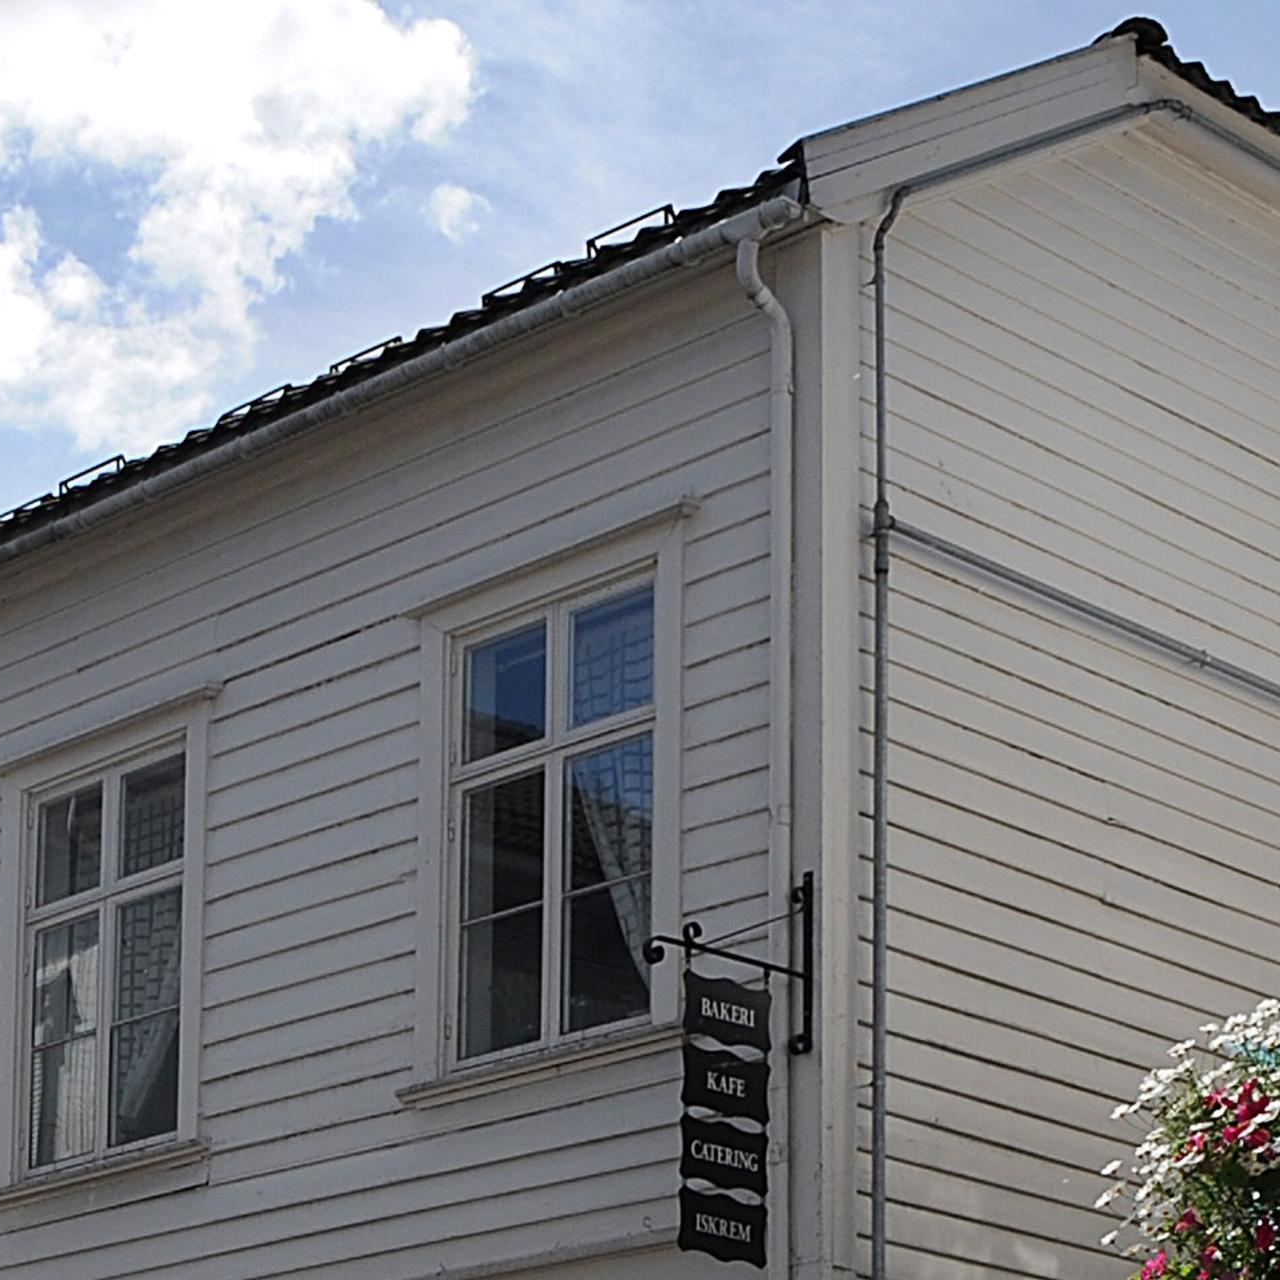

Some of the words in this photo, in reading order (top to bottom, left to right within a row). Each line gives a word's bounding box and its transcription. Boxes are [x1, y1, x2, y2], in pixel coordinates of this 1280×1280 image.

[701, 997, 755, 1027] BAKERI
[706, 1071, 746, 1097] KAFE
[690, 1140, 758, 1172] CATERING
[695, 1213, 752, 1243] ISKREM
